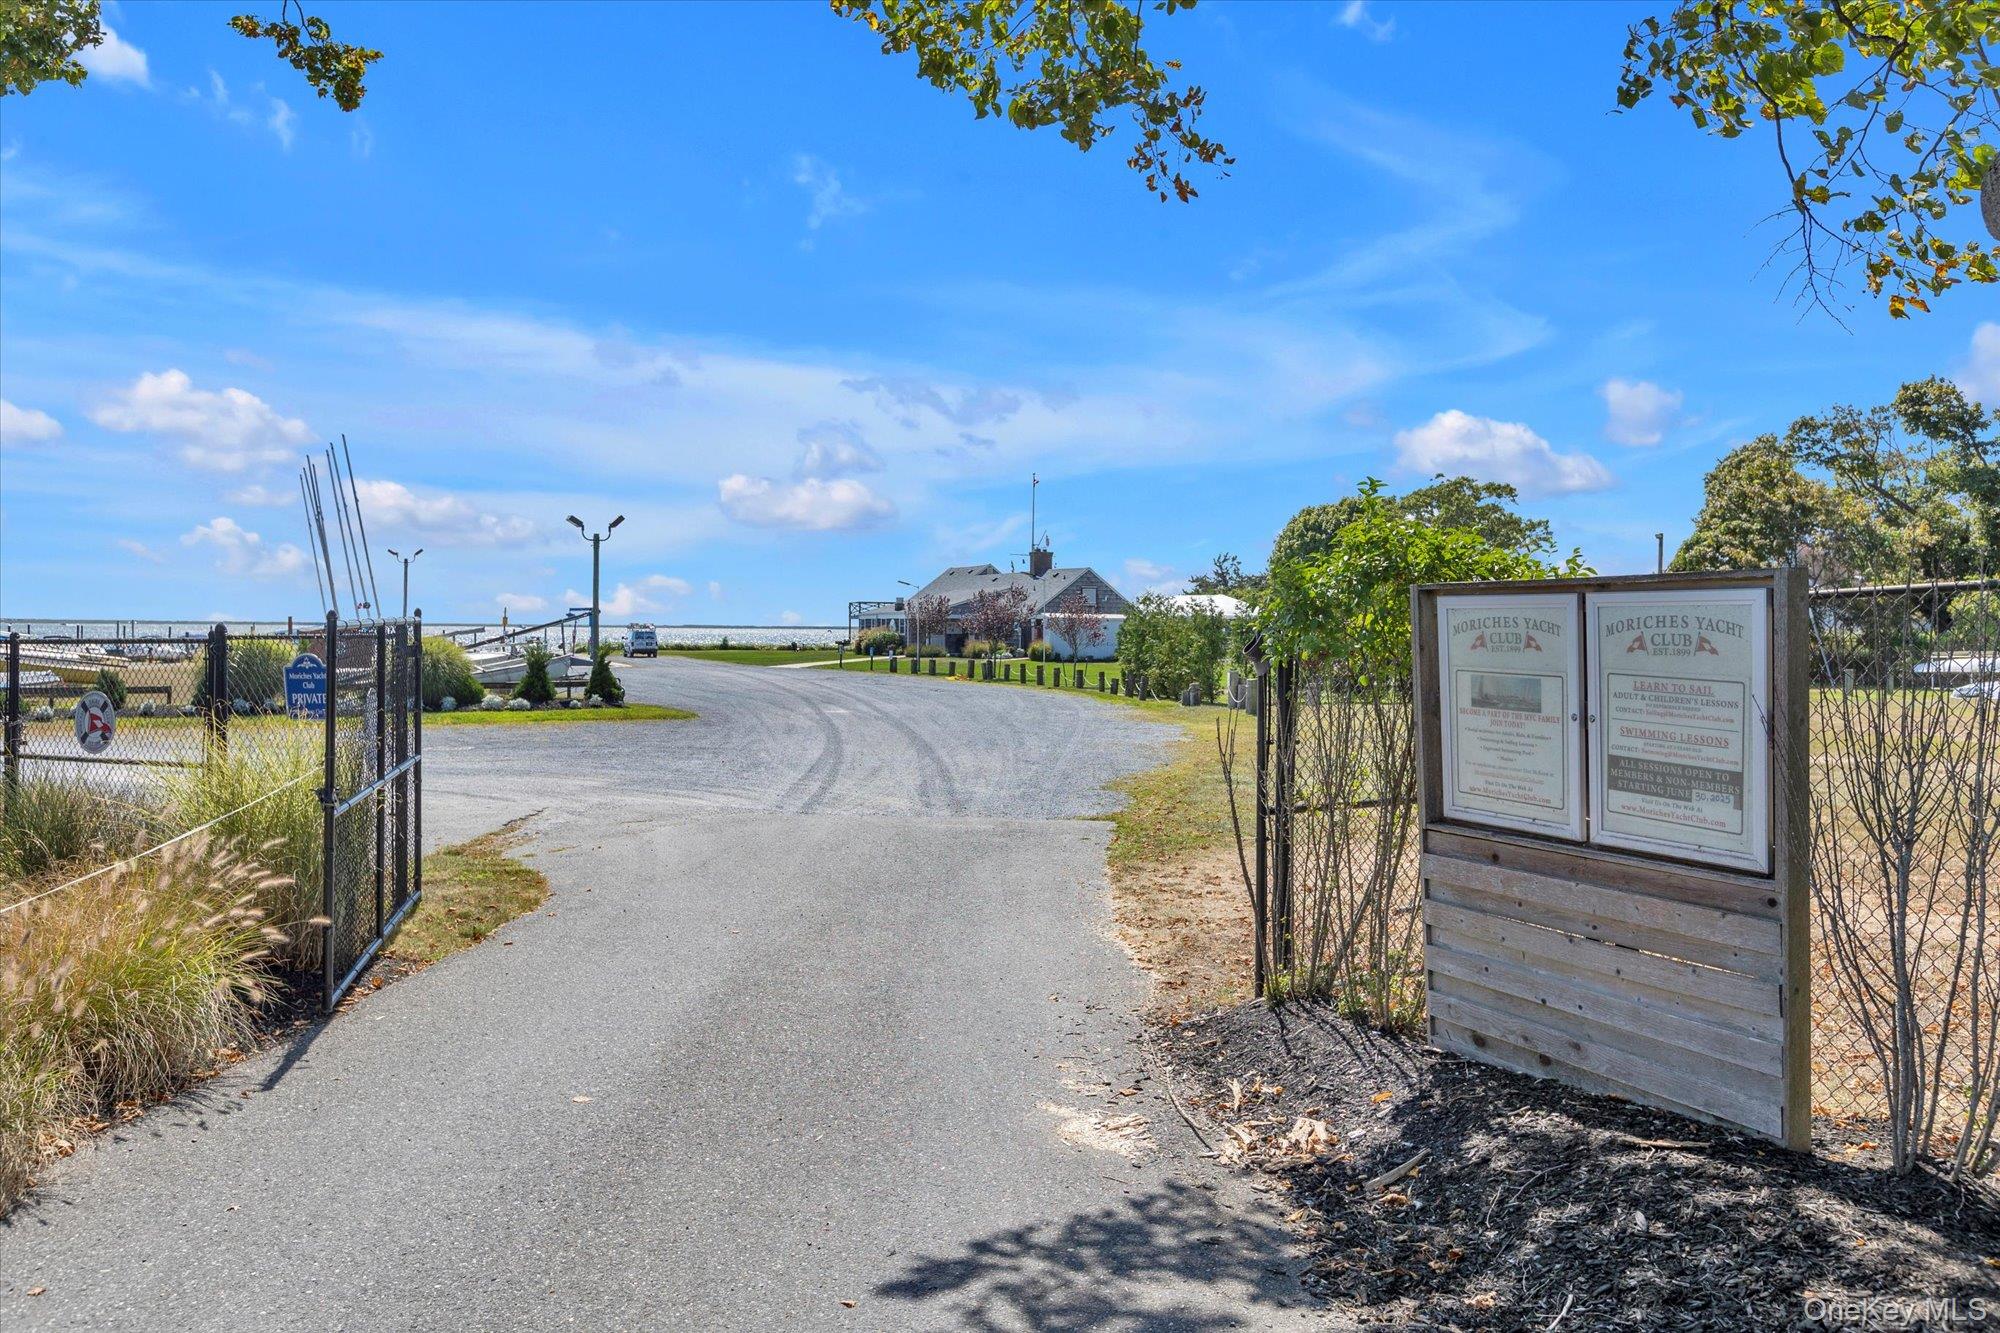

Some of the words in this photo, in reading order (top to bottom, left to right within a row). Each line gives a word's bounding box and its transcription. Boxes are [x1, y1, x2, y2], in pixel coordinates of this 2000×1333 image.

[1453, 616, 1519, 636] MORICHES
[1523, 617, 1561, 637] YACHT
[1606, 615, 1689, 637] MORICHES
[1695, 616, 1744, 639] YACHT
[1489, 632, 1522, 644] CLUB
[1651, 633, 1692, 647] CLUB
[289, 672, 312, 680] Moriches
[302, 681, 315, 689] Club
[1633, 680, 1669, 692] LEARN
[1671, 682, 1686, 693] TO
[1689, 684, 1713, 695] SAIL
[292, 693, 327, 704] PRIVATE
[1613, 691, 1640, 700] ADULT
[1648, 694, 1699, 706] CHILDREN'S
[1700, 699, 1740, 709] LESSONS
[1490, 719, 1503, 727] JOIN
[1620, 726, 1677, 741] SWIMMING
[1680, 733, 1729, 747] LESSONS
[1610, 768, 1654, 781] MEMBERS
[1619, 760, 1636, 769] ALL
[1638, 761, 1682, 774] SESSIONS
[1685, 767, 1712, 780] OPEN
[1716, 771, 1730, 782] TO
[1618, 780, 1664, 794] STARTING
[1665, 787, 1691, 799] JUNE
